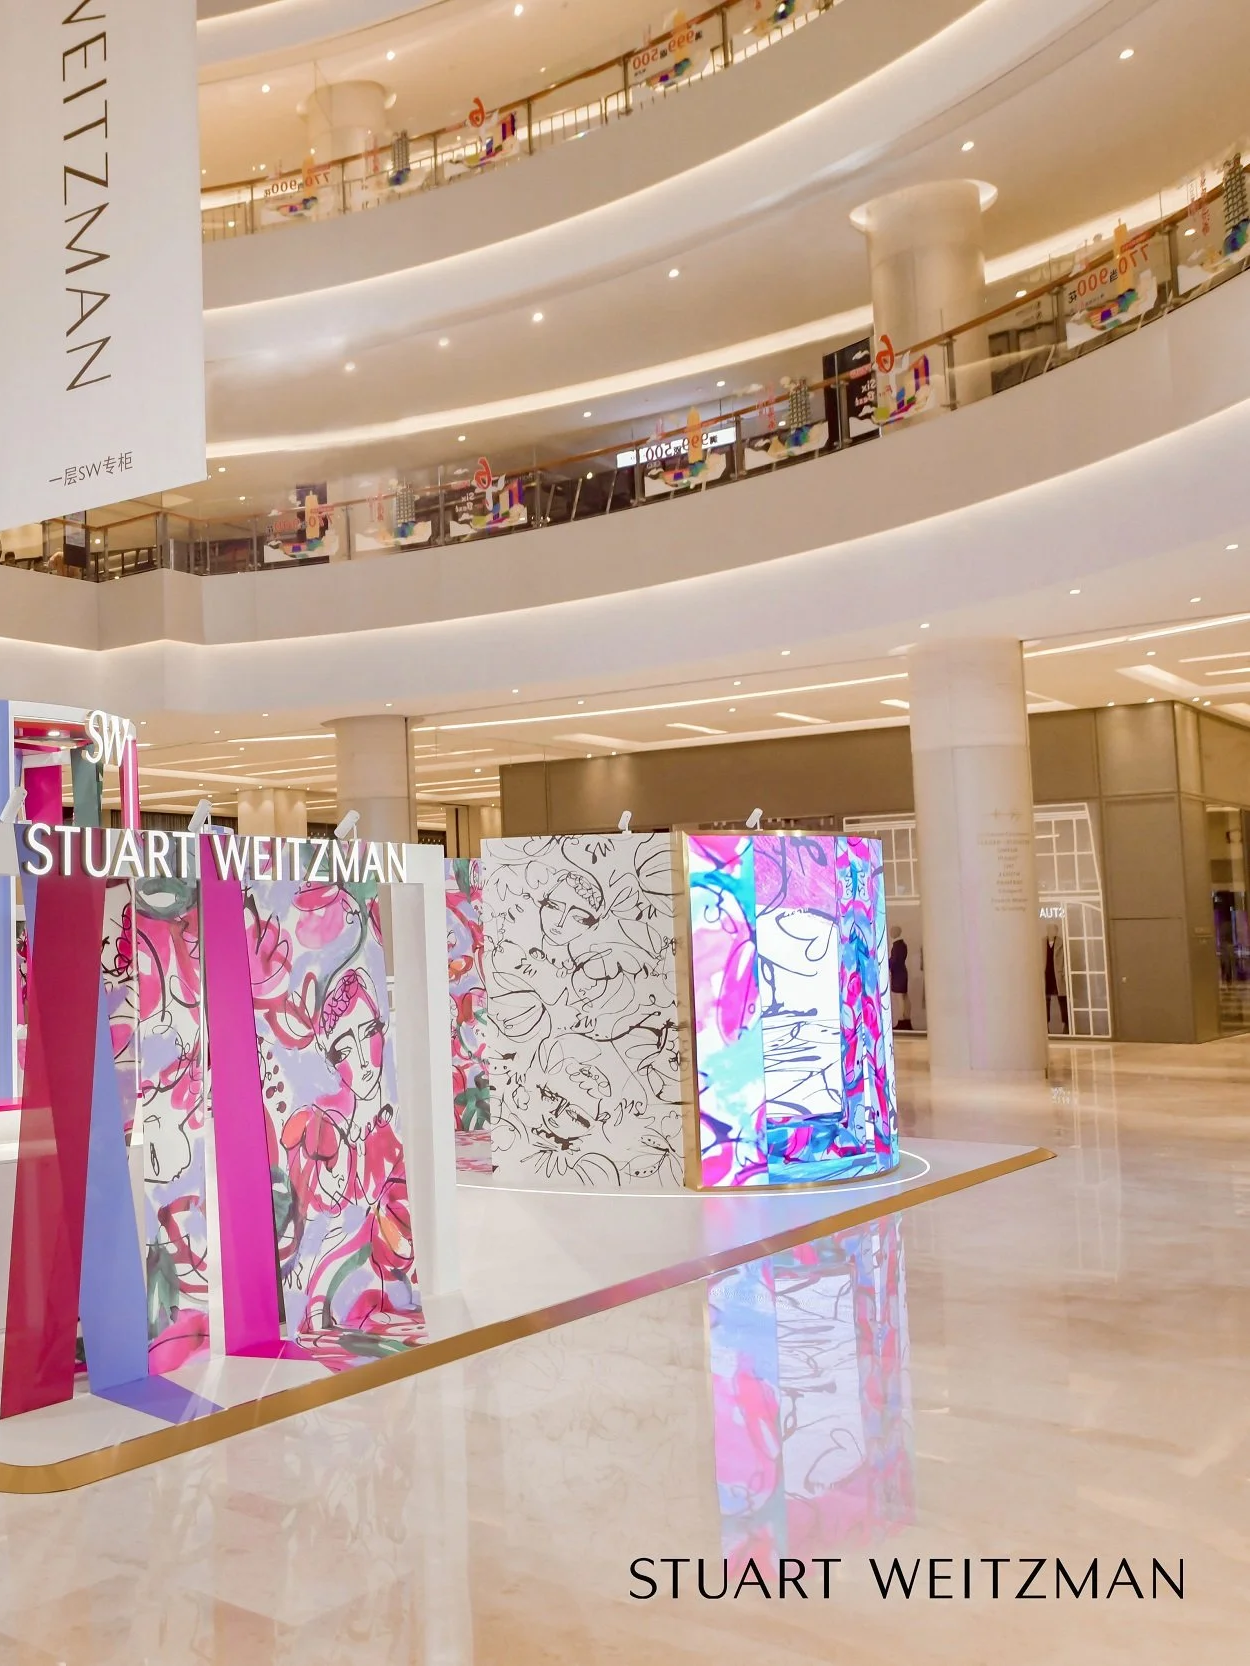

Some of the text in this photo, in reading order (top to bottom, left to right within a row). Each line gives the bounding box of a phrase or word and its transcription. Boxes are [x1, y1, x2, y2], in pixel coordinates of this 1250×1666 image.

[48, 451, 134, 487] 一层SW专柜
[85, 709, 131, 768] SW
[25, 823, 409, 884] STUART WEITZMAN
